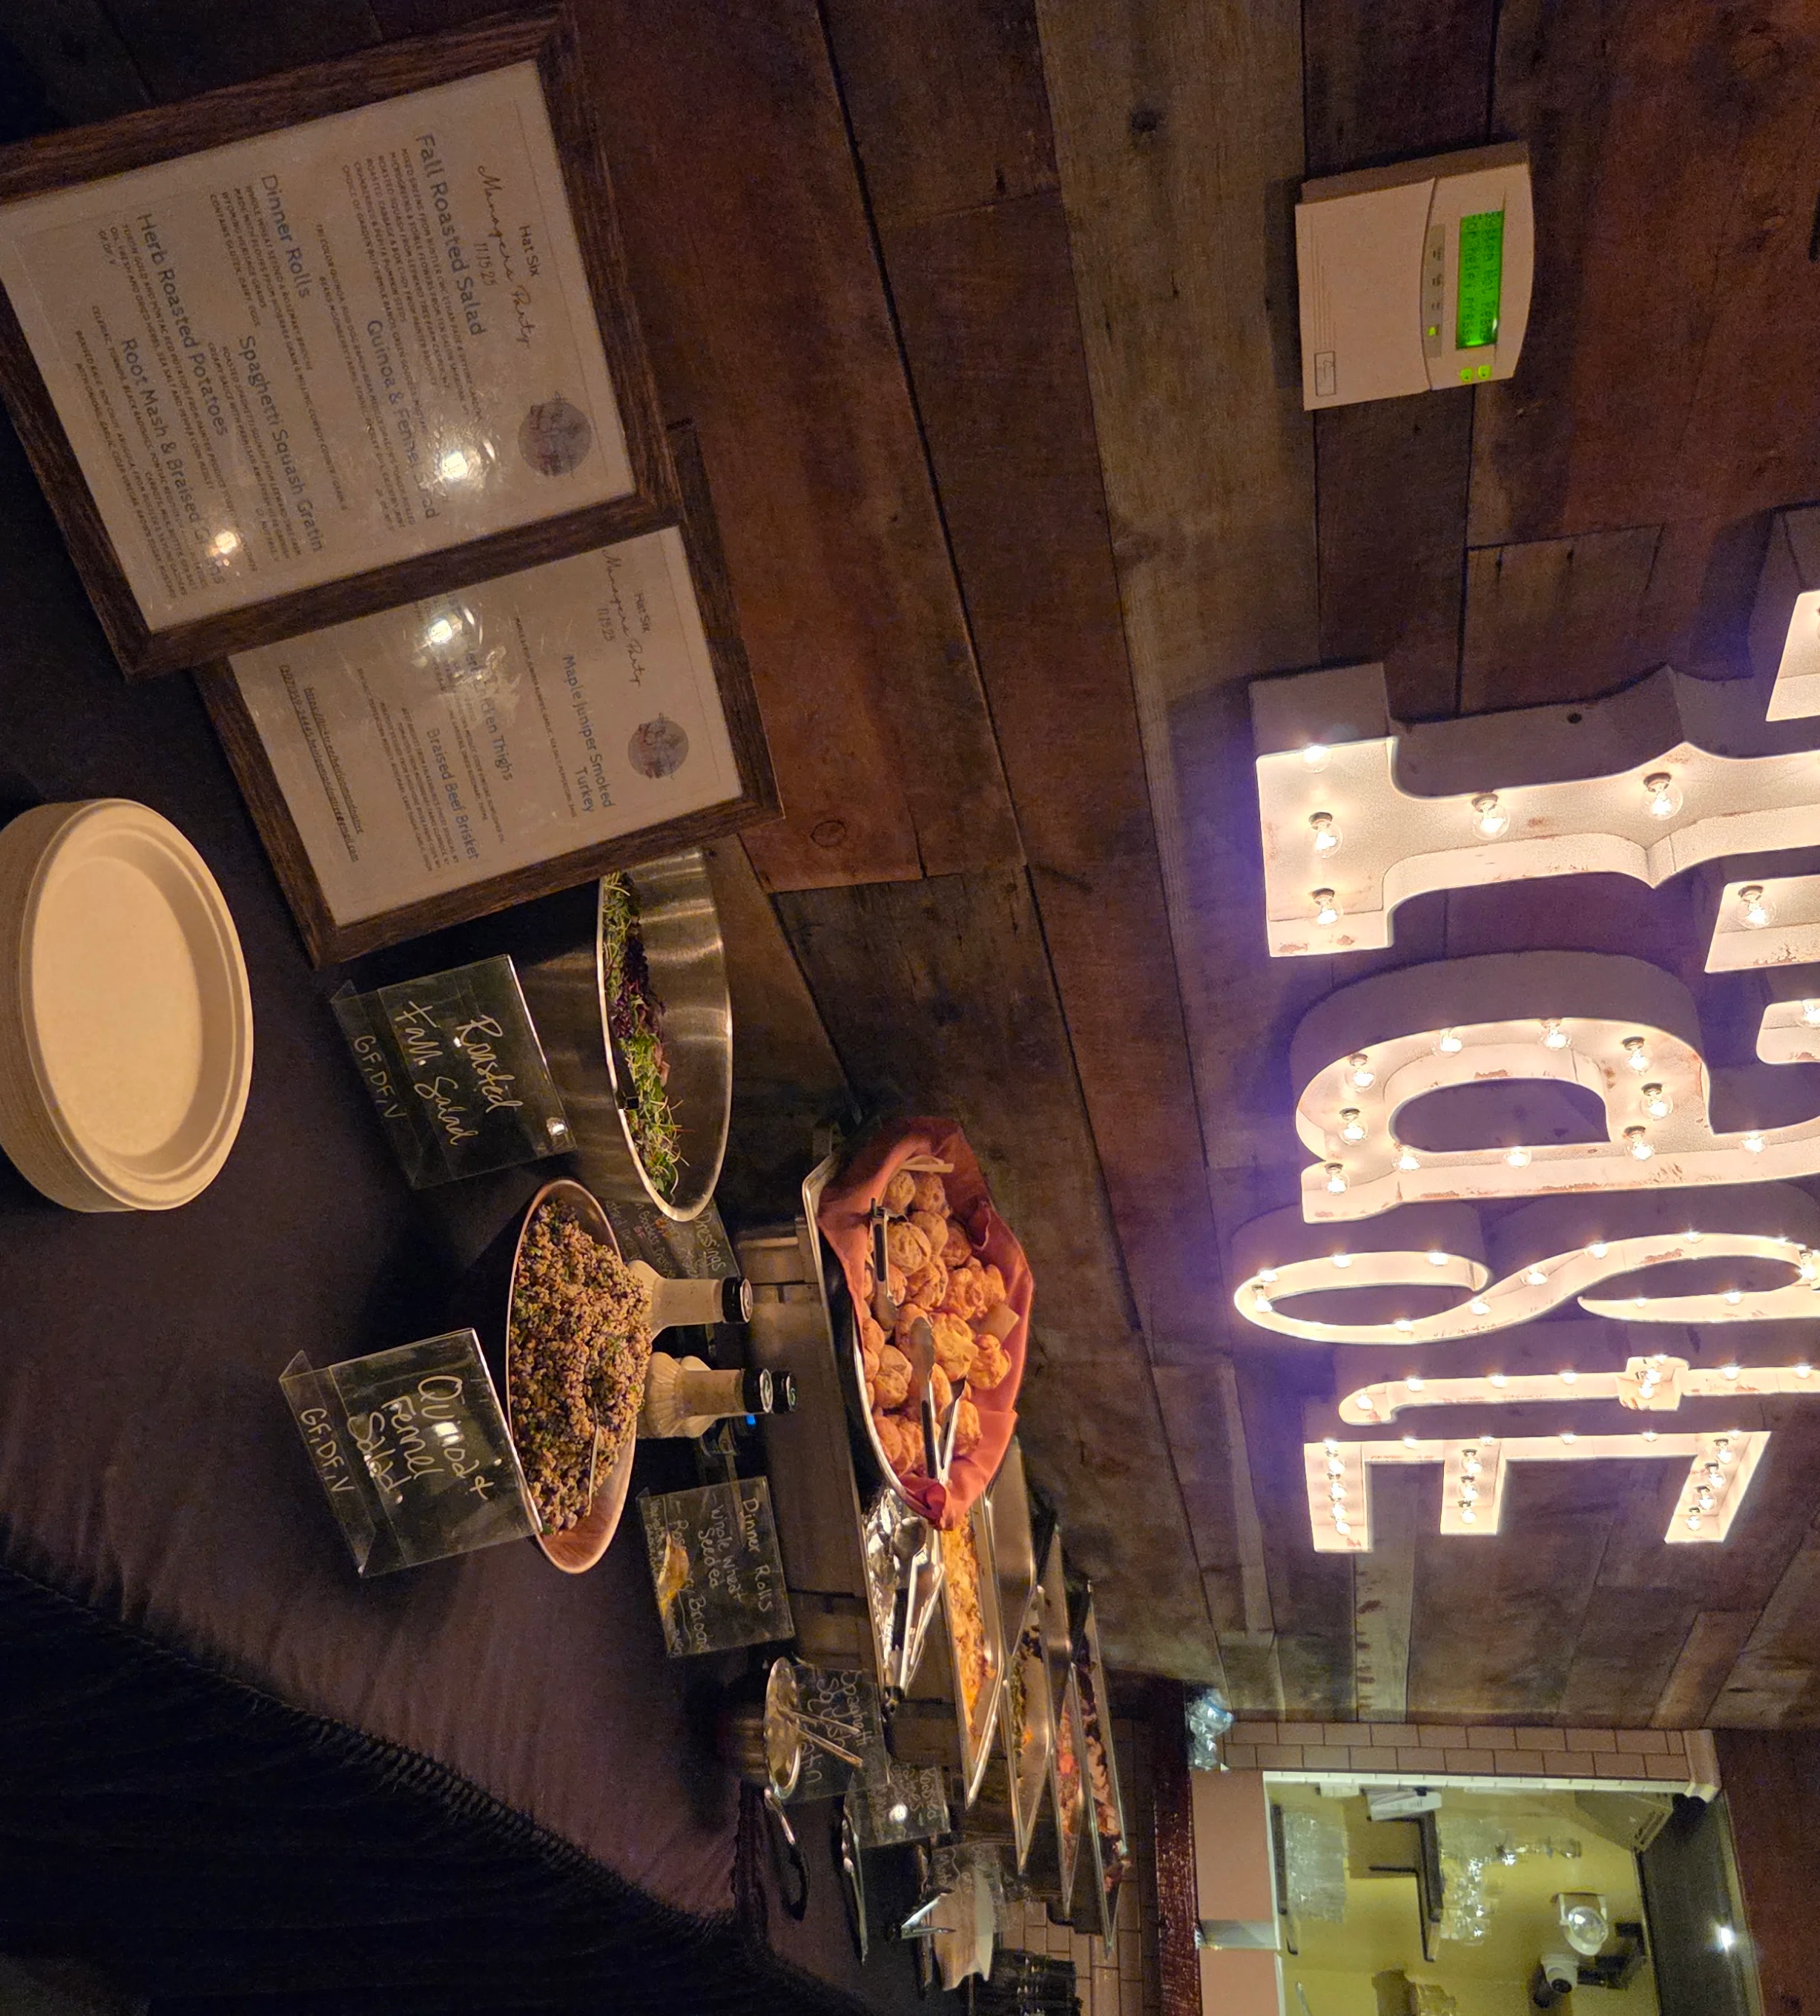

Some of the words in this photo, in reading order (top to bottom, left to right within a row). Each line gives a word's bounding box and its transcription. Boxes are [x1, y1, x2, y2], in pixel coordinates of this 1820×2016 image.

[415, 132, 445, 177] Fall
[260, 174, 295, 243] Dinner
[285, 246, 316, 299] Rolls
[429, 181, 469, 273] Roasted
[472, 162, 524, 284] Managers
[504, 283, 541, 352] Party
[518, 224, 535, 252] Hat
[527, 254, 541, 277] Six
[136, 213, 170, 266] Herb
[156, 268, 200, 349] Roasted
[185, 352, 230, 435] Potatoes
[455, 275, 488, 336] Salad
[119, 337, 152, 387] Root
[139, 387, 171, 438] Mash
[234, 335, 283, 427] Spaghetti
[268, 428, 306, 496] Squash
[295, 498, 327, 553] Gratin
[364, 319, 401, 389] Quinoa
[386, 389, 405, 405] &
[412, 470, 441, 519] Sad
[159, 440, 179, 455] &
[165, 456, 204, 524] Braised
[597, 546, 639, 639] Managers
[619, 637, 651, 689] Party
[633, 593, 647, 614] Hat
[639, 614, 653, 633] Six
[426, 728, 455, 780] Braised
[487, 734, 516, 783] Thighs
[557, 654, 585, 702] Maple
[571, 700, 600, 753] Juniper
[588, 752, 616, 808] Smoked
[444, 781, 466, 814] Beef
[571, 766, 599, 814] Turkey
[454, 814, 481, 861] Brisket
[395, 1001, 441, 1062] Fall
[455, 1015, 523, 1113] Roasted
[414, 1077, 478, 1144] Salad
[693, 1212, 726, 1271] Dressings
[346, 1412, 411, 1493] Salad
[380, 1396, 444, 1479] Fennel
[418, 1375, 479, 1478] Quoa
[698, 1529, 724, 1589] Seeded
[710, 1506, 733, 1552] Whole
[724, 1557, 744, 1602] Wheat
[742, 1498, 761, 1552] Dinner
[754, 1564, 773, 1611] Rolls
[807, 1678, 851, 1747] Sqush
[831, 1670, 873, 1746] Spaghetti
